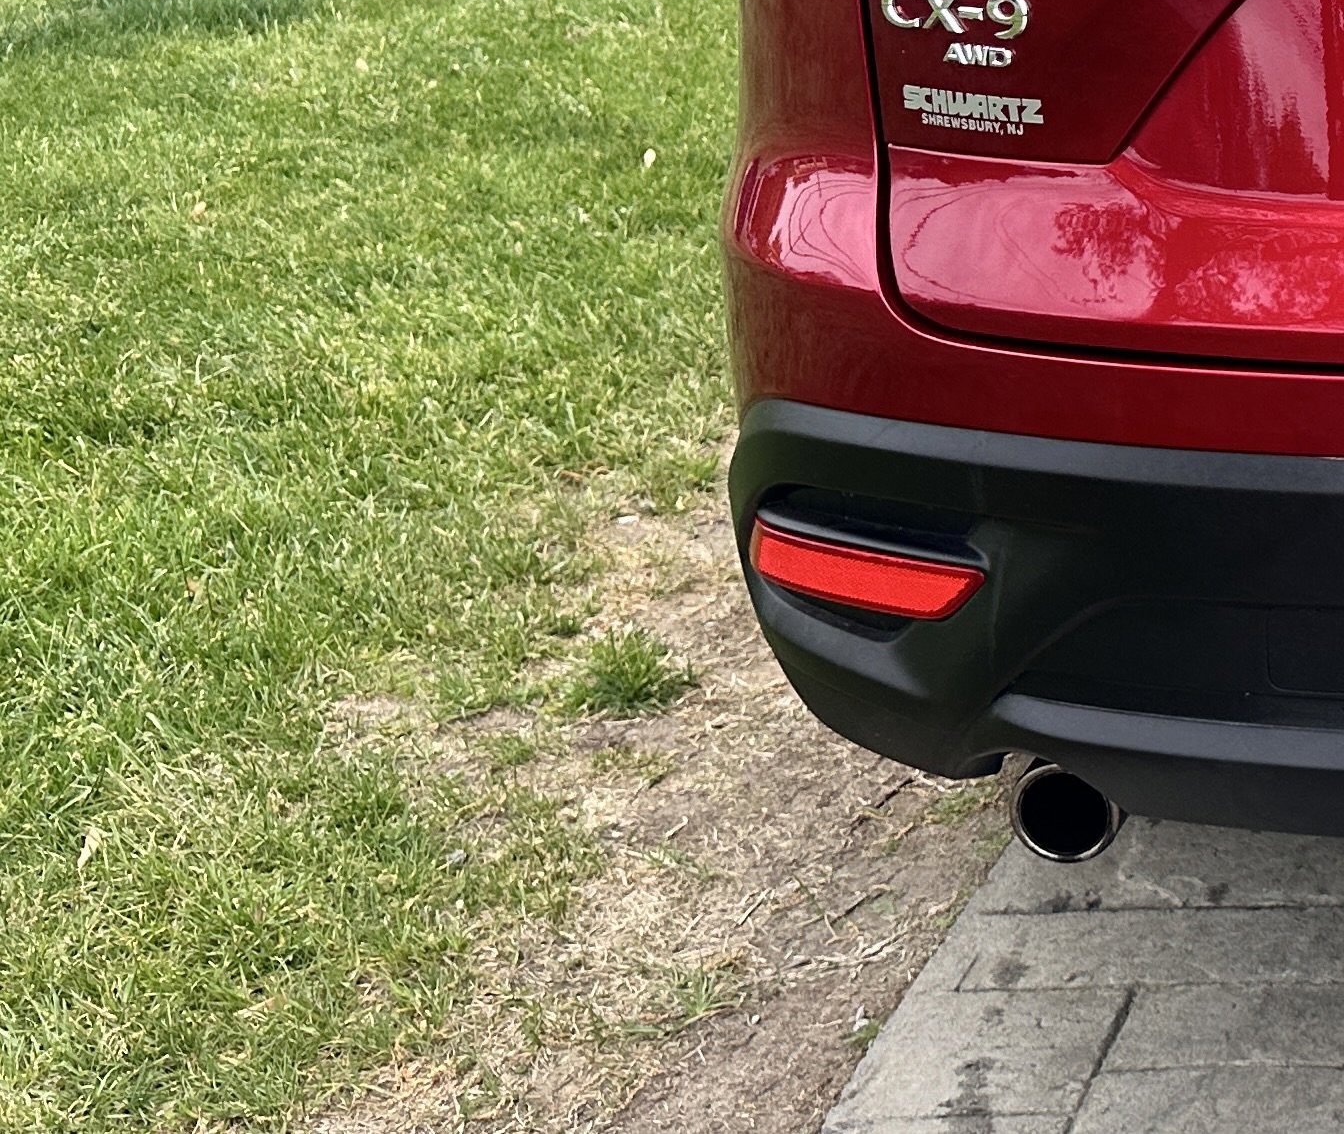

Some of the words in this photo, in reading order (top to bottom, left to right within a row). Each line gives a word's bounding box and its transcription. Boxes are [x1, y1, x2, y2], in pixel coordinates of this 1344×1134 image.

[943, 42, 1013, 67] AWD
[902, 84, 1044, 124] SCHWARTZ
[921, 112, 1003, 135] SHREWSBURY,
[1007, 122, 1024, 136] NJ
